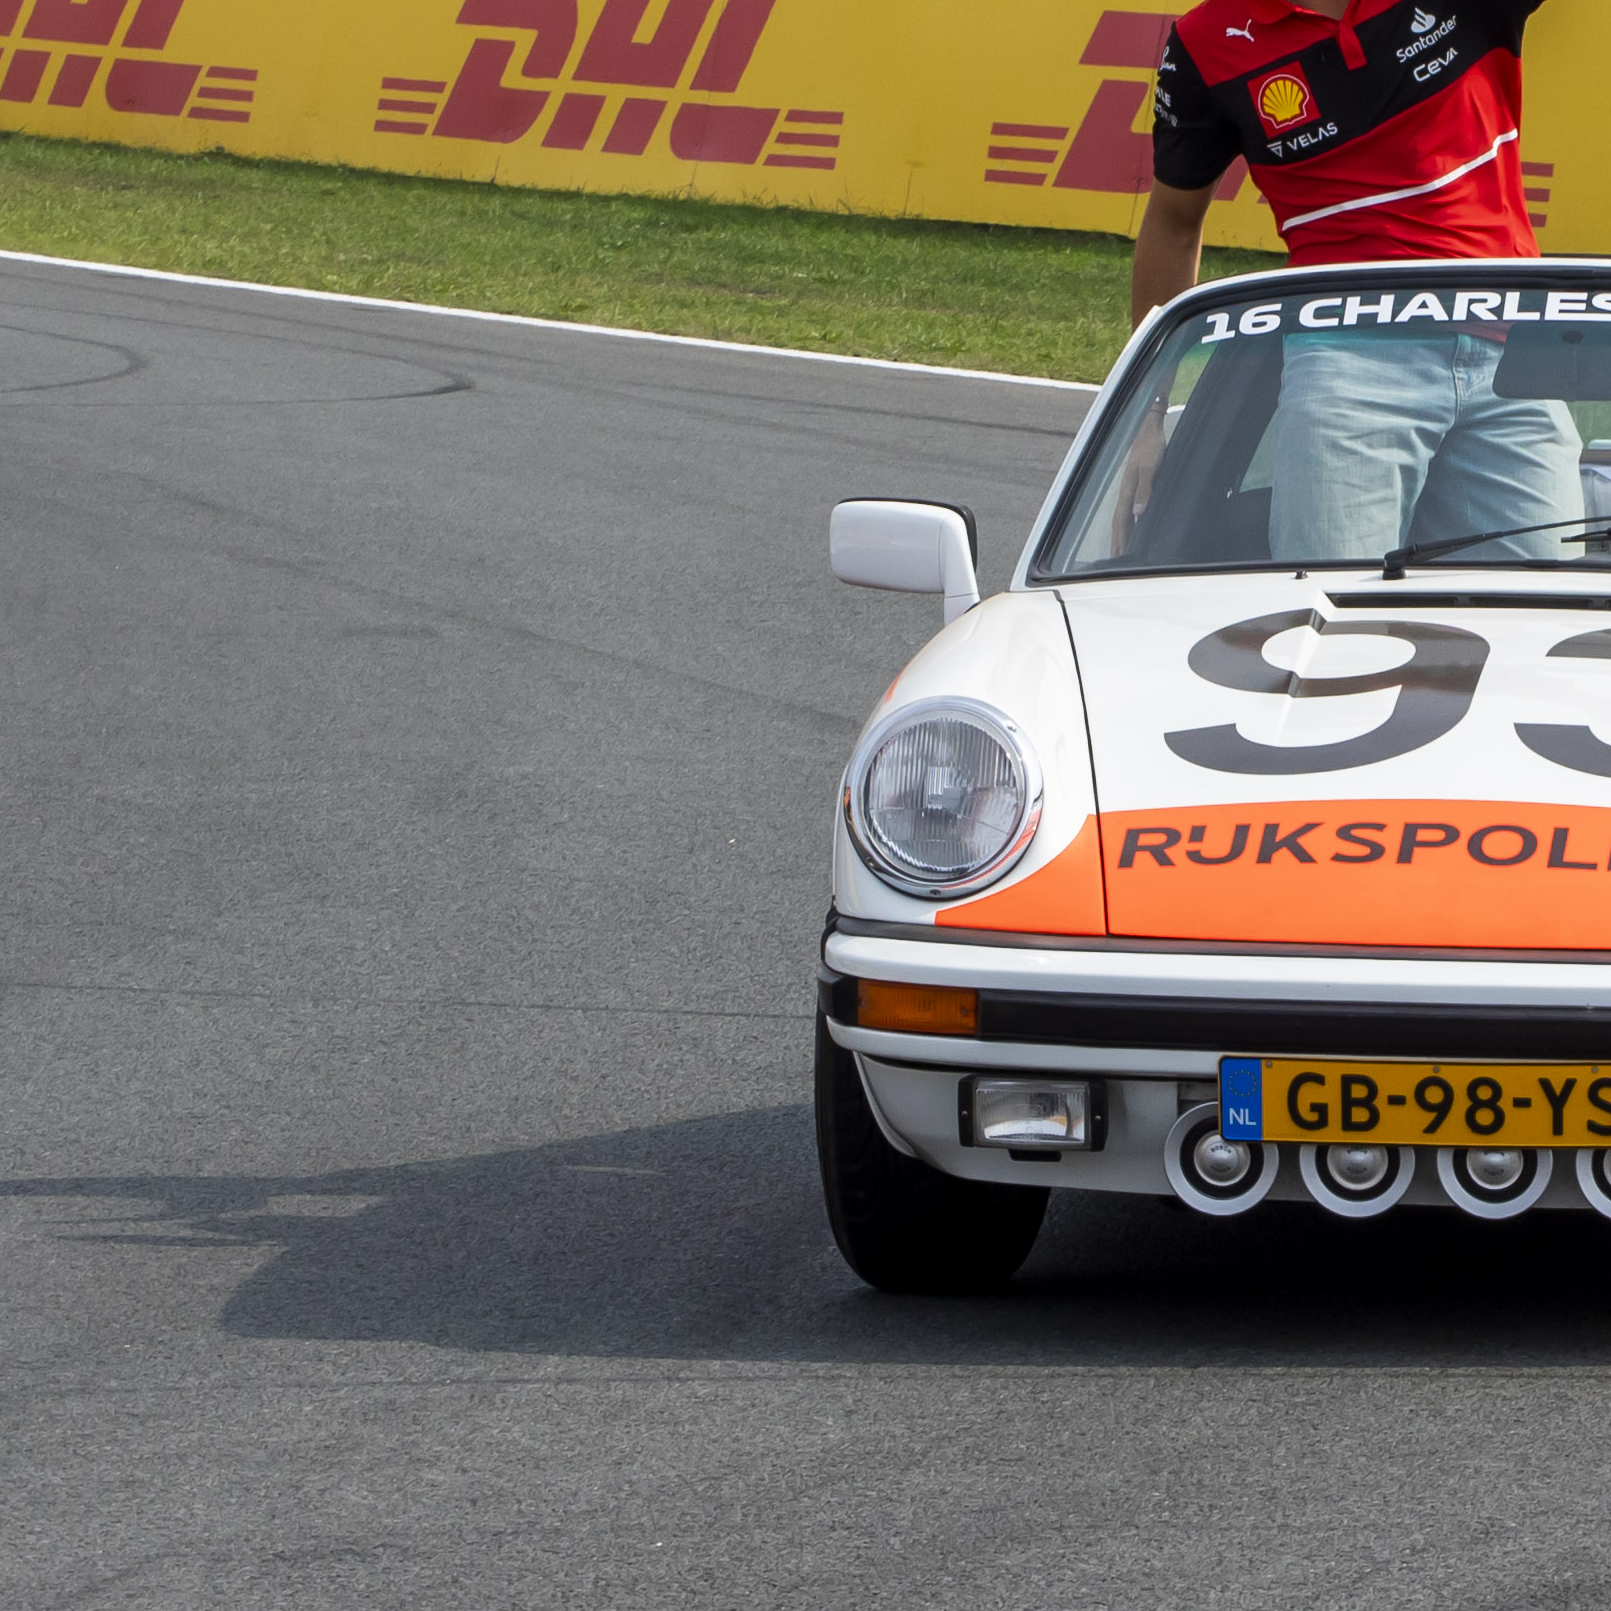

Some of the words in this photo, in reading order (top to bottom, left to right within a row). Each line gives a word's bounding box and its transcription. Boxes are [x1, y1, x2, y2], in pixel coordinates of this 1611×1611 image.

[1396, 15, 1457, 63] Santander
[1286, 122, 1338, 151] VELAS
[1201, 303, 1282, 344] 16
[1229, 1107, 1257, 1126] NL
